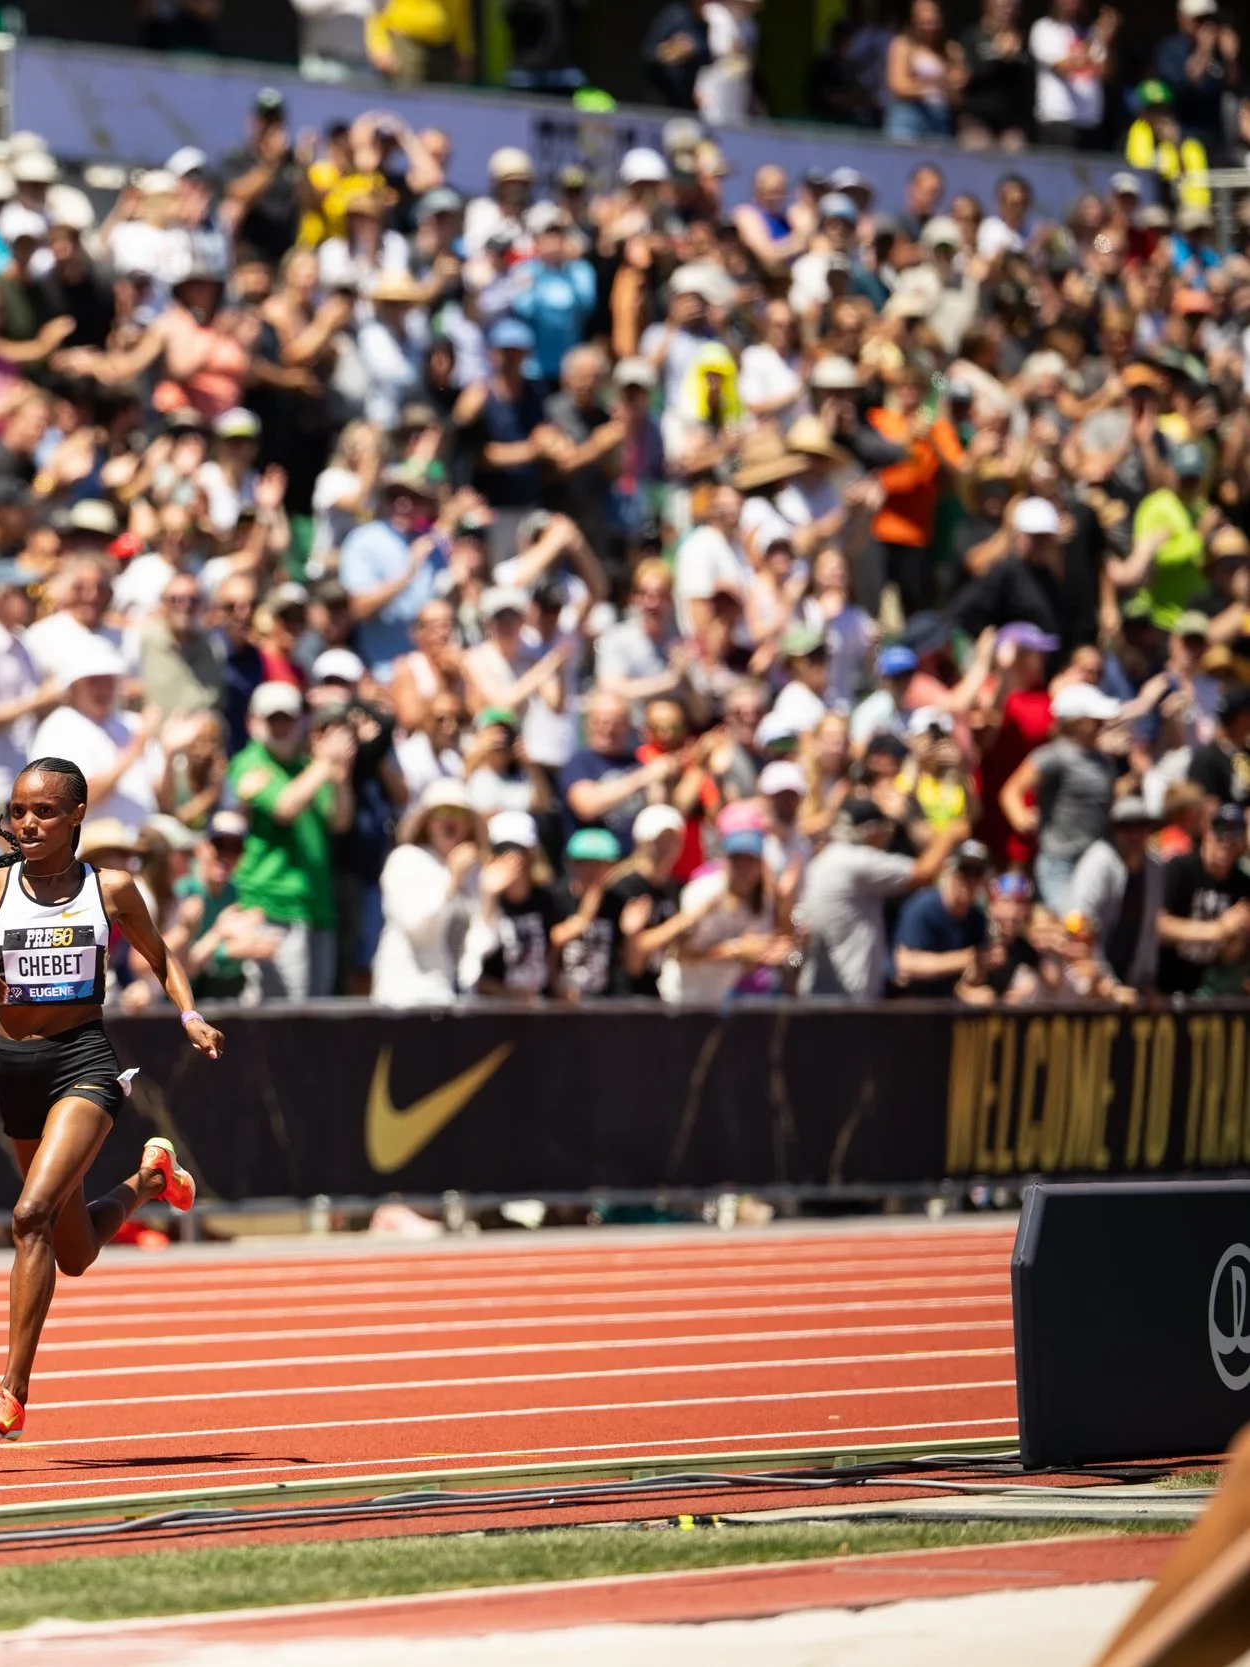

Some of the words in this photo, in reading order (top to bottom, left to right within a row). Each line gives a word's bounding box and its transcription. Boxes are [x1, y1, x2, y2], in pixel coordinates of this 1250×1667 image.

[18, 953, 83, 977] CHEBET
[29, 986, 75, 998] EUGENE
[945, 1014, 1120, 1173] WELCOME
[1124, 1013, 1177, 1169] TO
[1184, 1014, 1250, 1167] TRA
